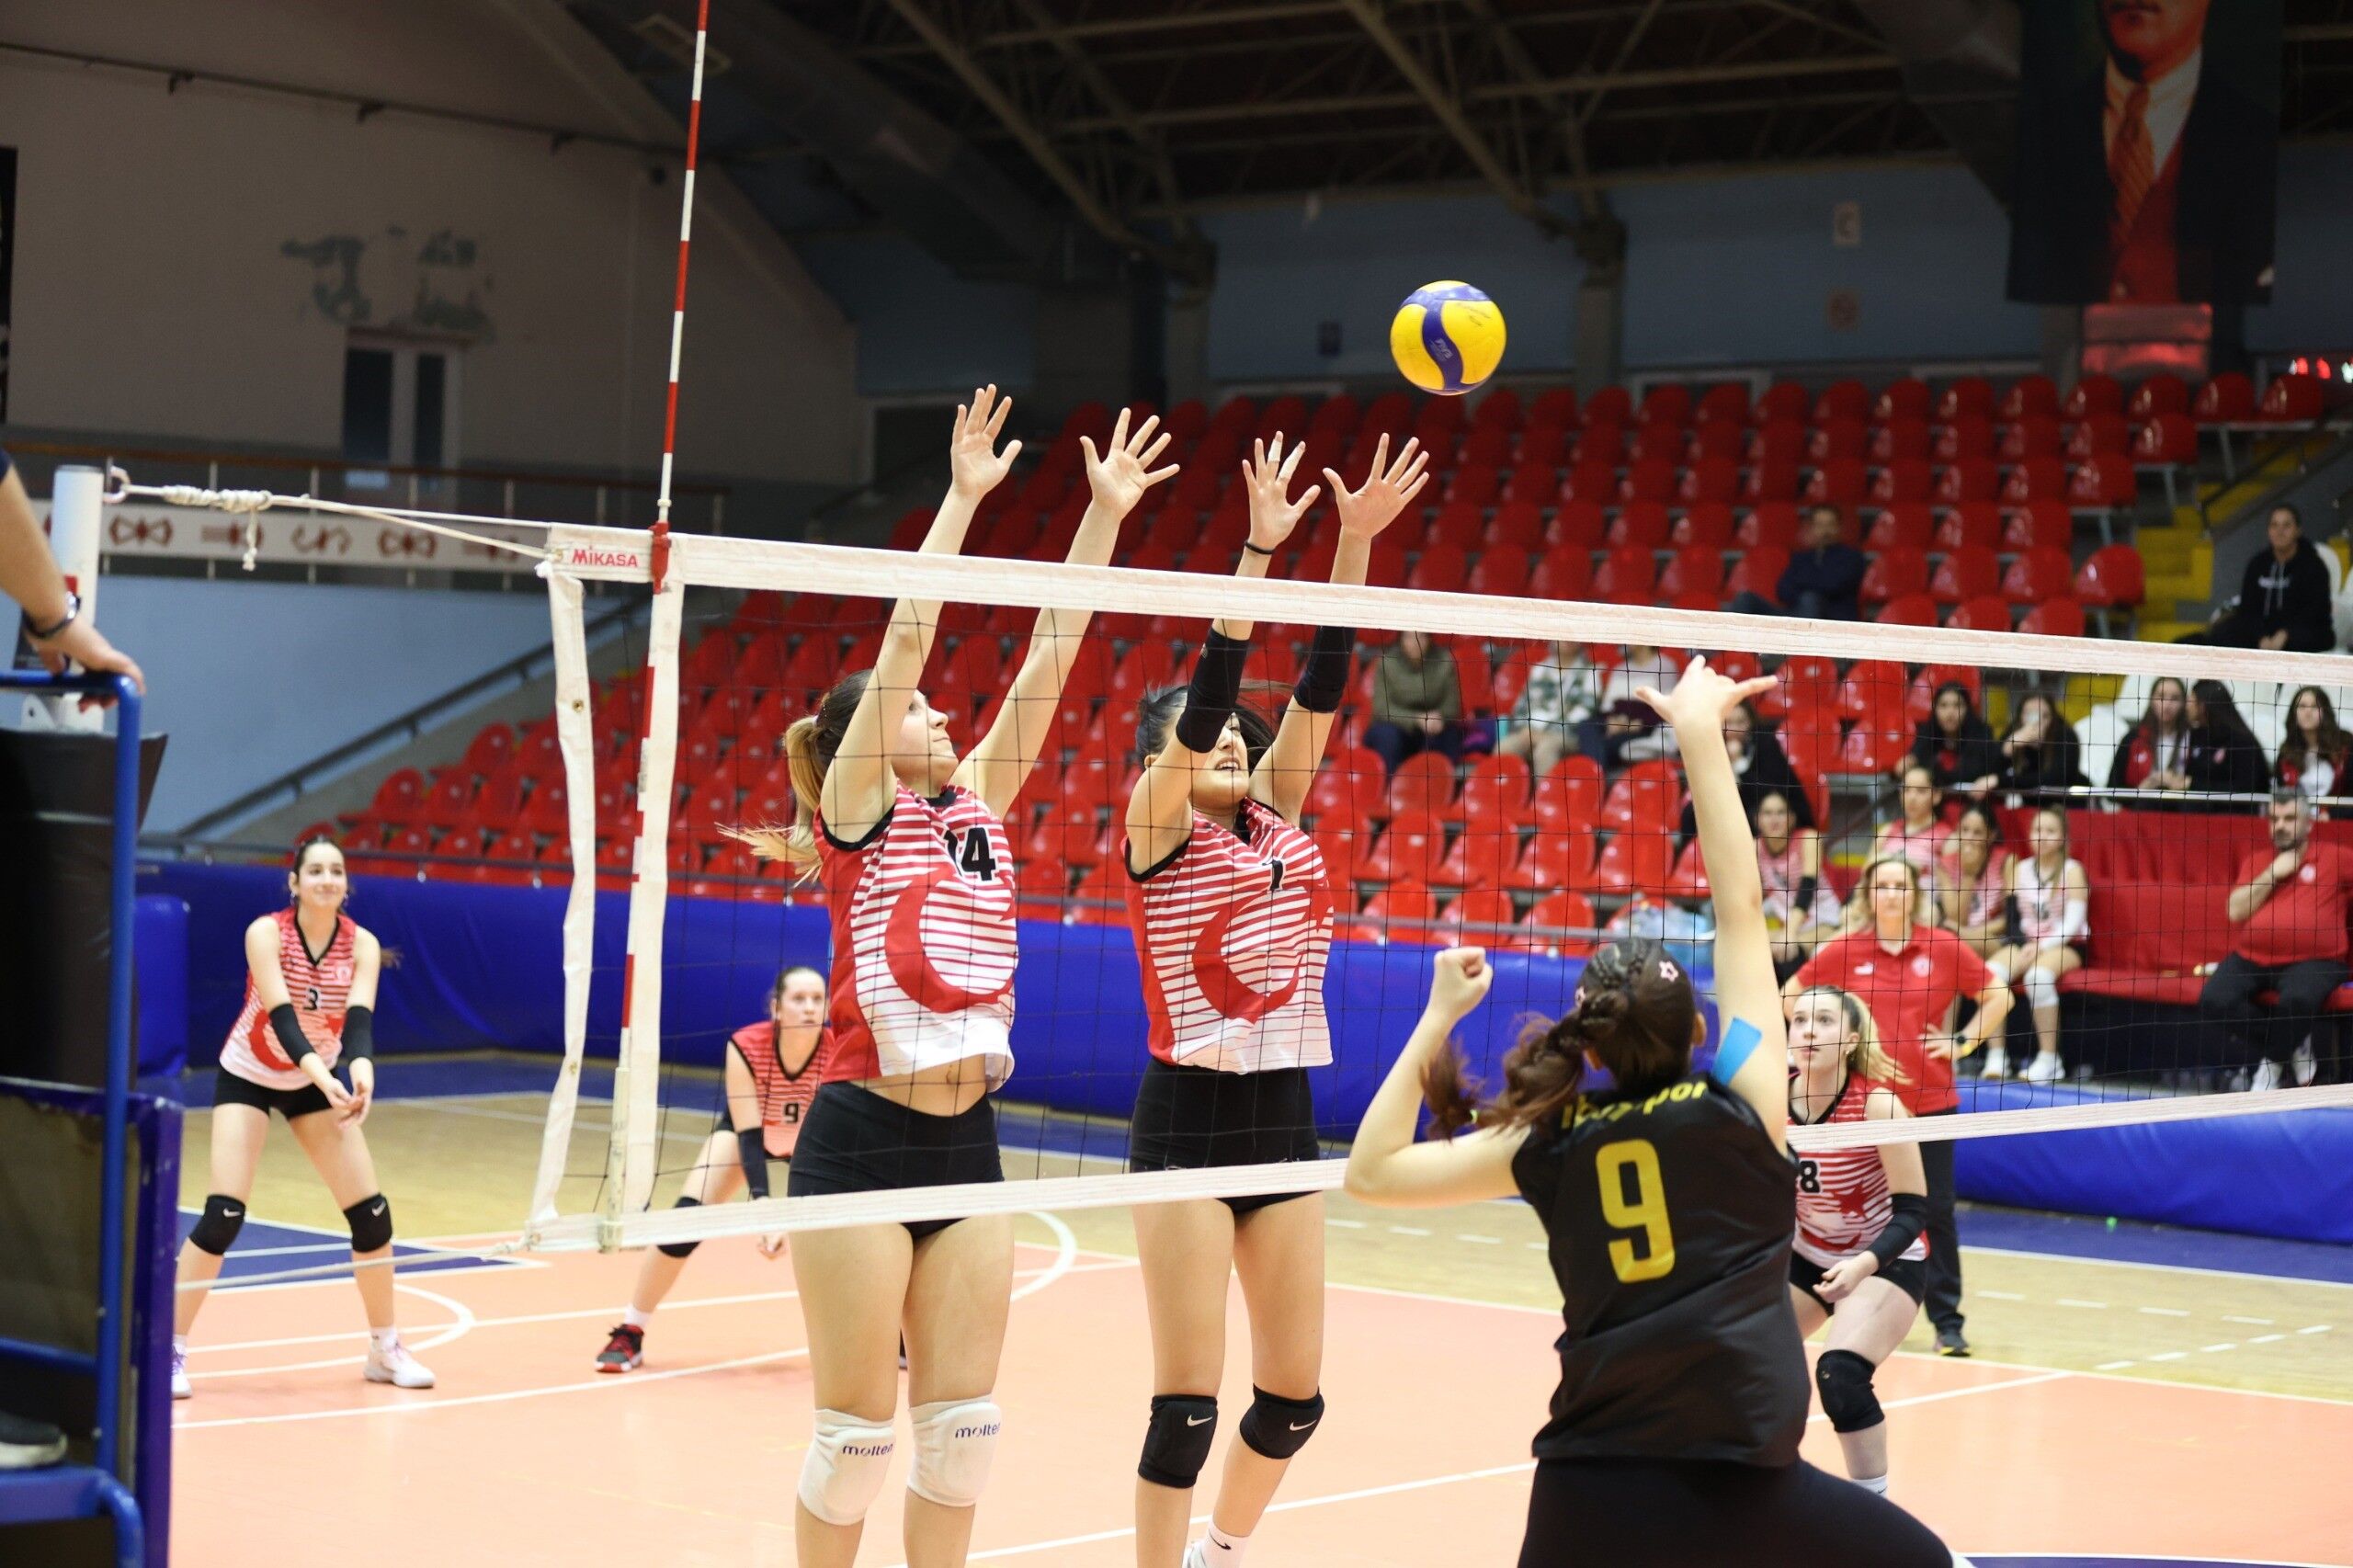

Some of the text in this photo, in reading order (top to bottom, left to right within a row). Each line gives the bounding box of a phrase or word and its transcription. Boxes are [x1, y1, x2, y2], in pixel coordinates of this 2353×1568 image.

[944, 827, 996, 881] 14
[303, 988, 318, 1011] 3
[784, 1103, 799, 1123] 9
[1800, 1160, 1821, 1194] 8
[1596, 1139, 1676, 1284] 9
